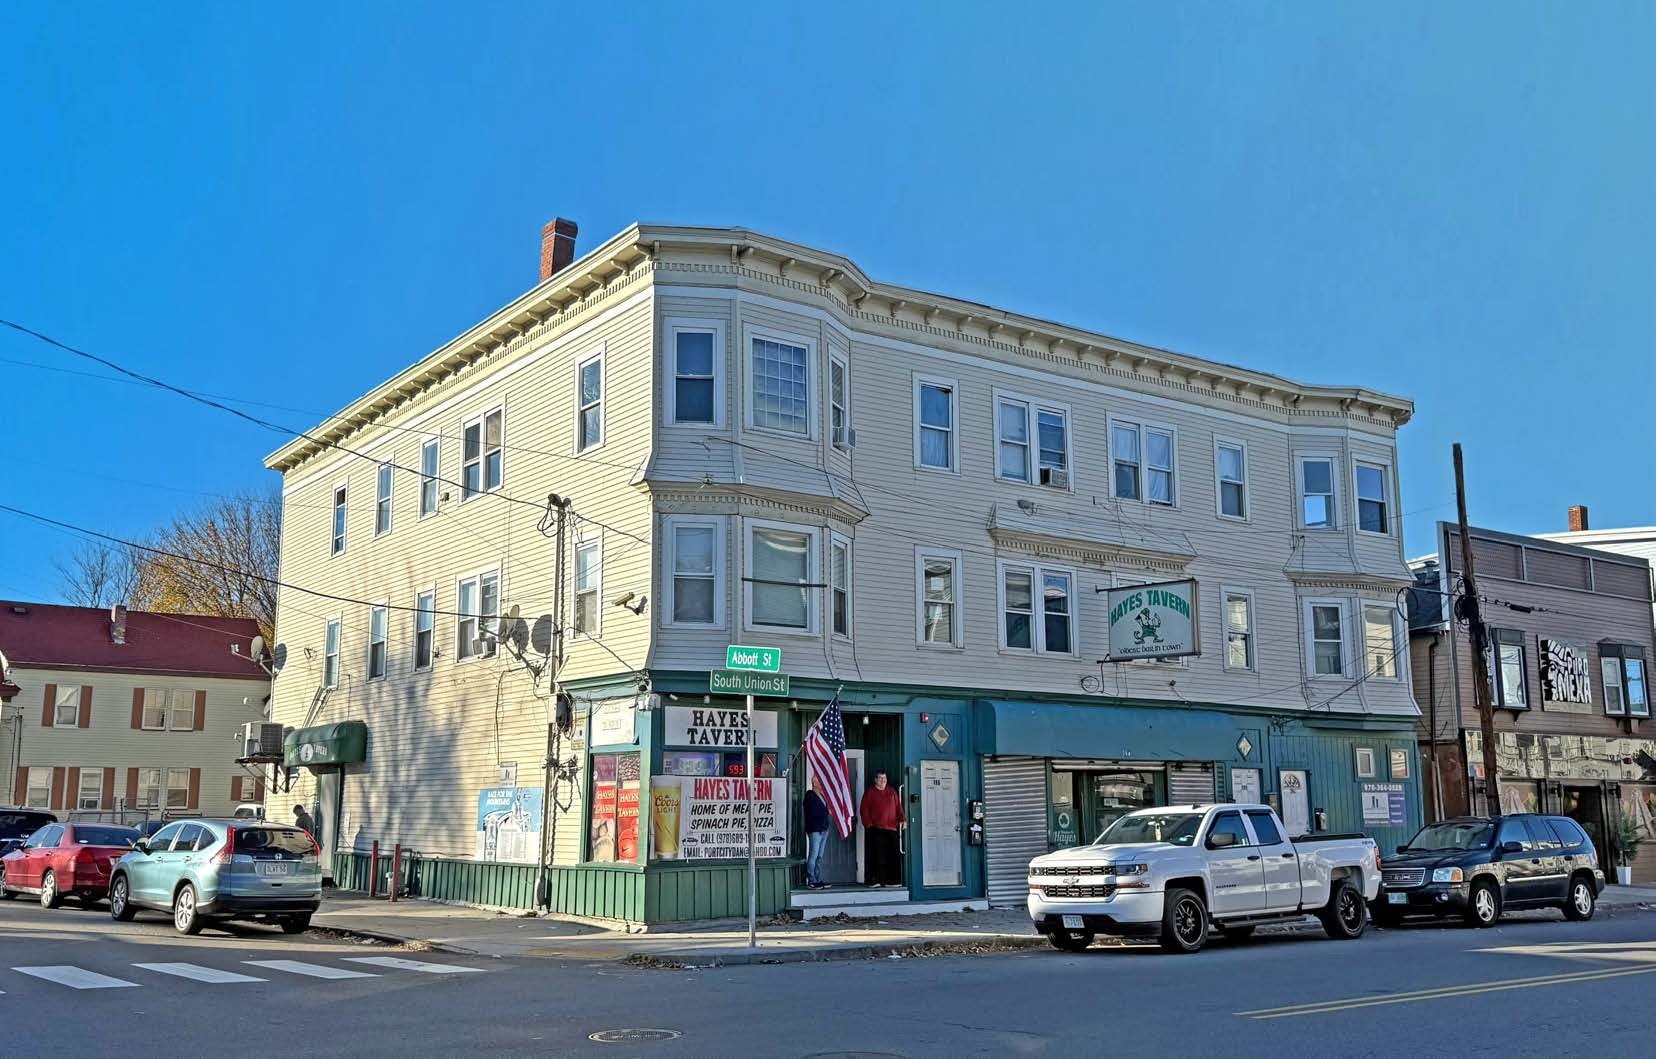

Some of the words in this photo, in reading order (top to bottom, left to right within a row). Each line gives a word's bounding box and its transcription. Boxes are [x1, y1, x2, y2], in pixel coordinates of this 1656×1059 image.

[1110, 591, 1143, 627] HAYES
[1147, 589, 1190, 620] TAVERN
[731, 651, 759, 666] Abbott
[763, 652, 772, 667] St
[1567, 656, 1589, 675] PURO
[713, 674, 741, 688] South
[744, 676, 772, 690] Union
[773, 678, 785, 691] St
[1558, 671, 1592, 704] MEXA
[692, 710, 749, 727] HAYES
[694, 778, 730, 800] HAYES
[654, 795, 680, 807] Coors
[691, 804, 717, 815] HOME
[719, 803, 730, 815] OF
[758, 802, 774, 815] PIE,
[691, 818, 729, 830] SPINACH
[732, 817, 747, 829] PIE,
[700, 833, 715, 844] CALL
[758, 833, 766, 843] OR
[683, 847, 704, 858] EMAIL:
[705, 846, 782, 858] PORTCITYDAN@HOO.COM
